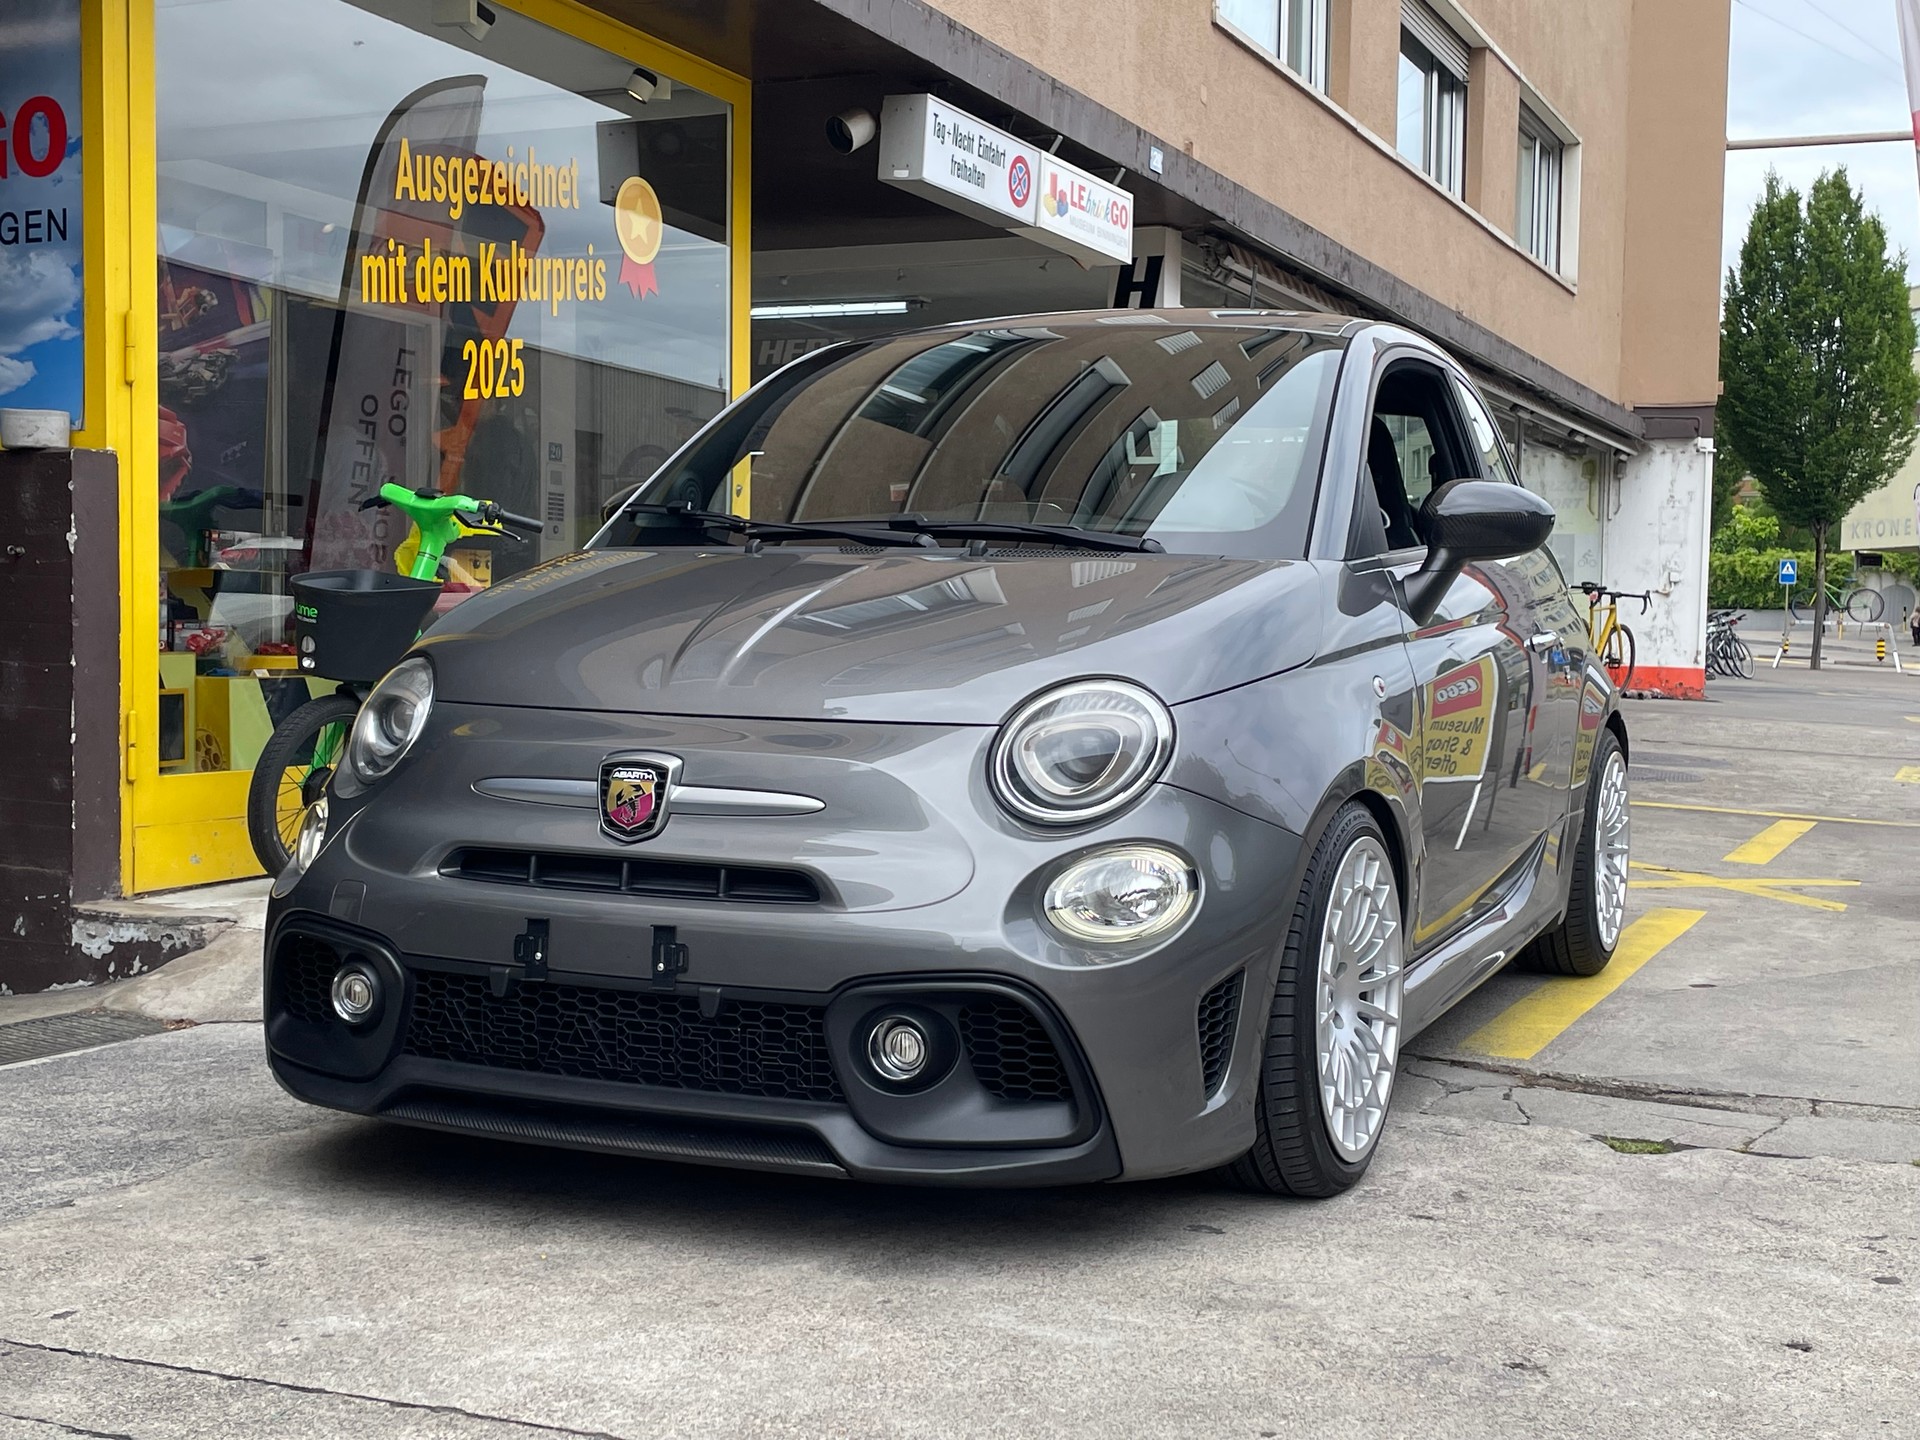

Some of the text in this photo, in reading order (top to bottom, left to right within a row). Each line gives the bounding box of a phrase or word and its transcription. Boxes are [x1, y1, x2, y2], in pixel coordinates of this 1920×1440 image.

[0, 95, 68, 179] O
[932, 112, 946, 145] Tag
[951, 122, 975, 154] Nacht
[977, 134, 1006, 169] Einfahrt
[395, 138, 580, 220] Ausgezeichnet
[950, 154, 986, 189] freihalten
[0, 208, 67, 245] GEN
[362, 238, 407, 304] mit
[415, 238, 471, 304] dem
[479, 240, 607, 317] Kulturpreis
[463, 338, 525, 400] 2025
[347, 394, 379, 505] OFFEN
[1851, 518, 1919, 539] KRONE
[613, 771, 653, 780] ABARTH
[418, 997, 814, 1088] ABARTH
